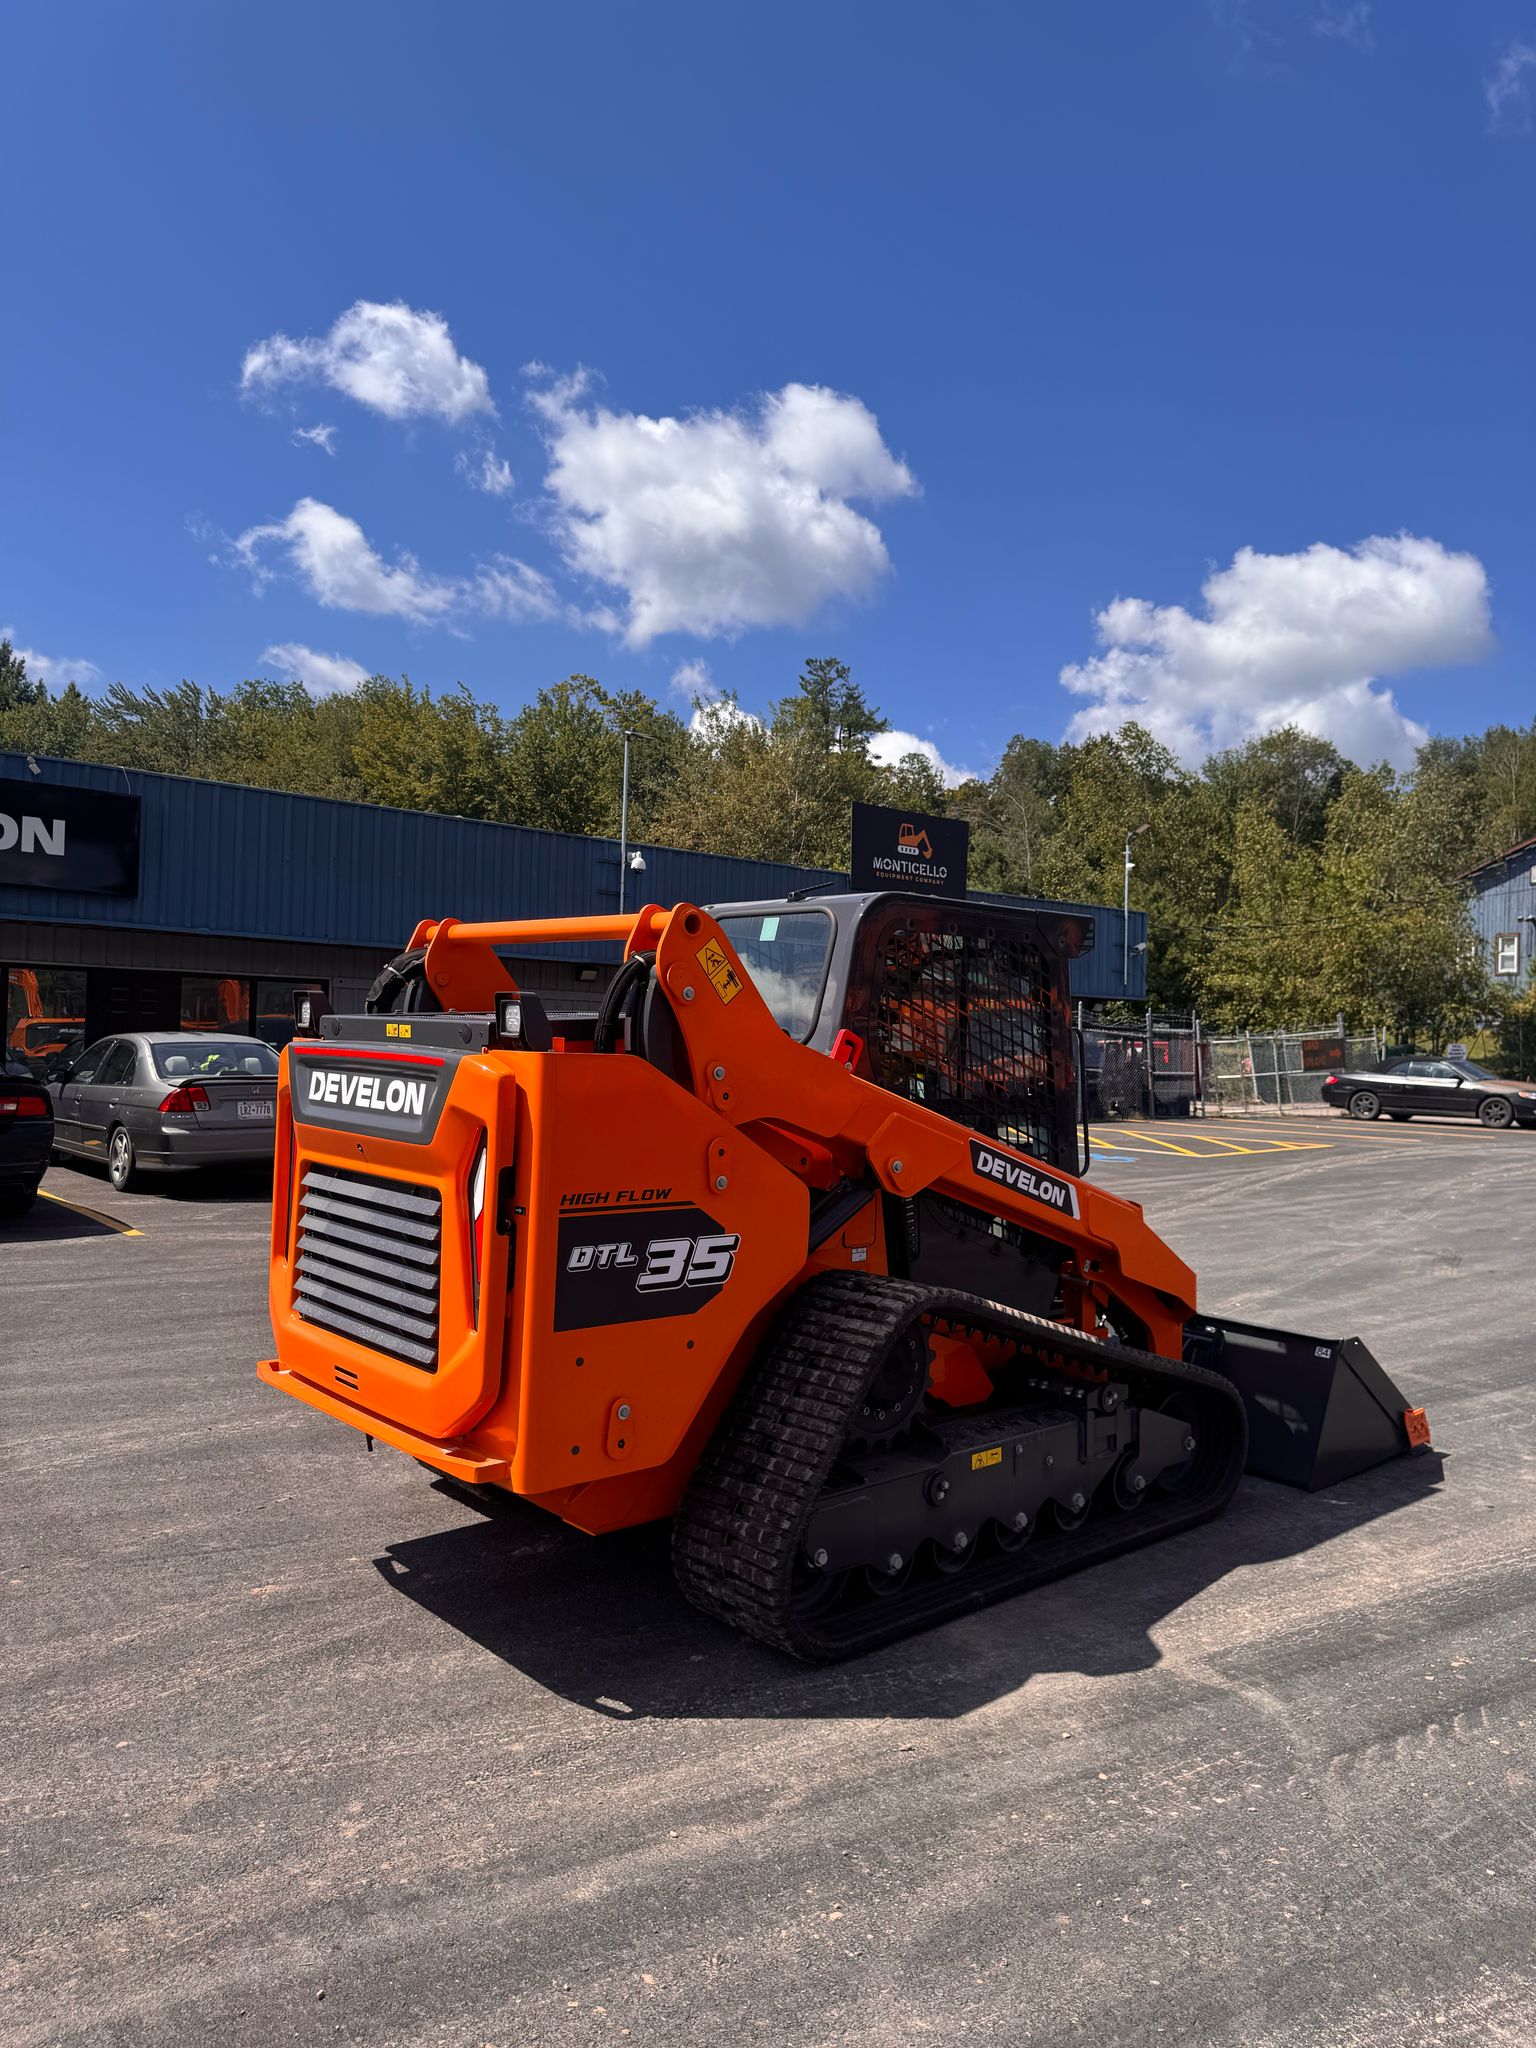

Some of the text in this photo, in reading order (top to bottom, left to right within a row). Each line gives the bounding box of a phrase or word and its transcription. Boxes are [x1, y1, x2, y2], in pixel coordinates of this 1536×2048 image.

[873, 857, 947, 878] MONTICELLO
[876, 871, 944, 885] EQUIPMENT COMPANY
[308, 1071, 427, 1116] DEVELON
[977, 1151, 1065, 1207] DEVELON
[560, 1188, 672, 1206] HIGH FLOW
[567, 1233, 741, 1293] DTL 35
